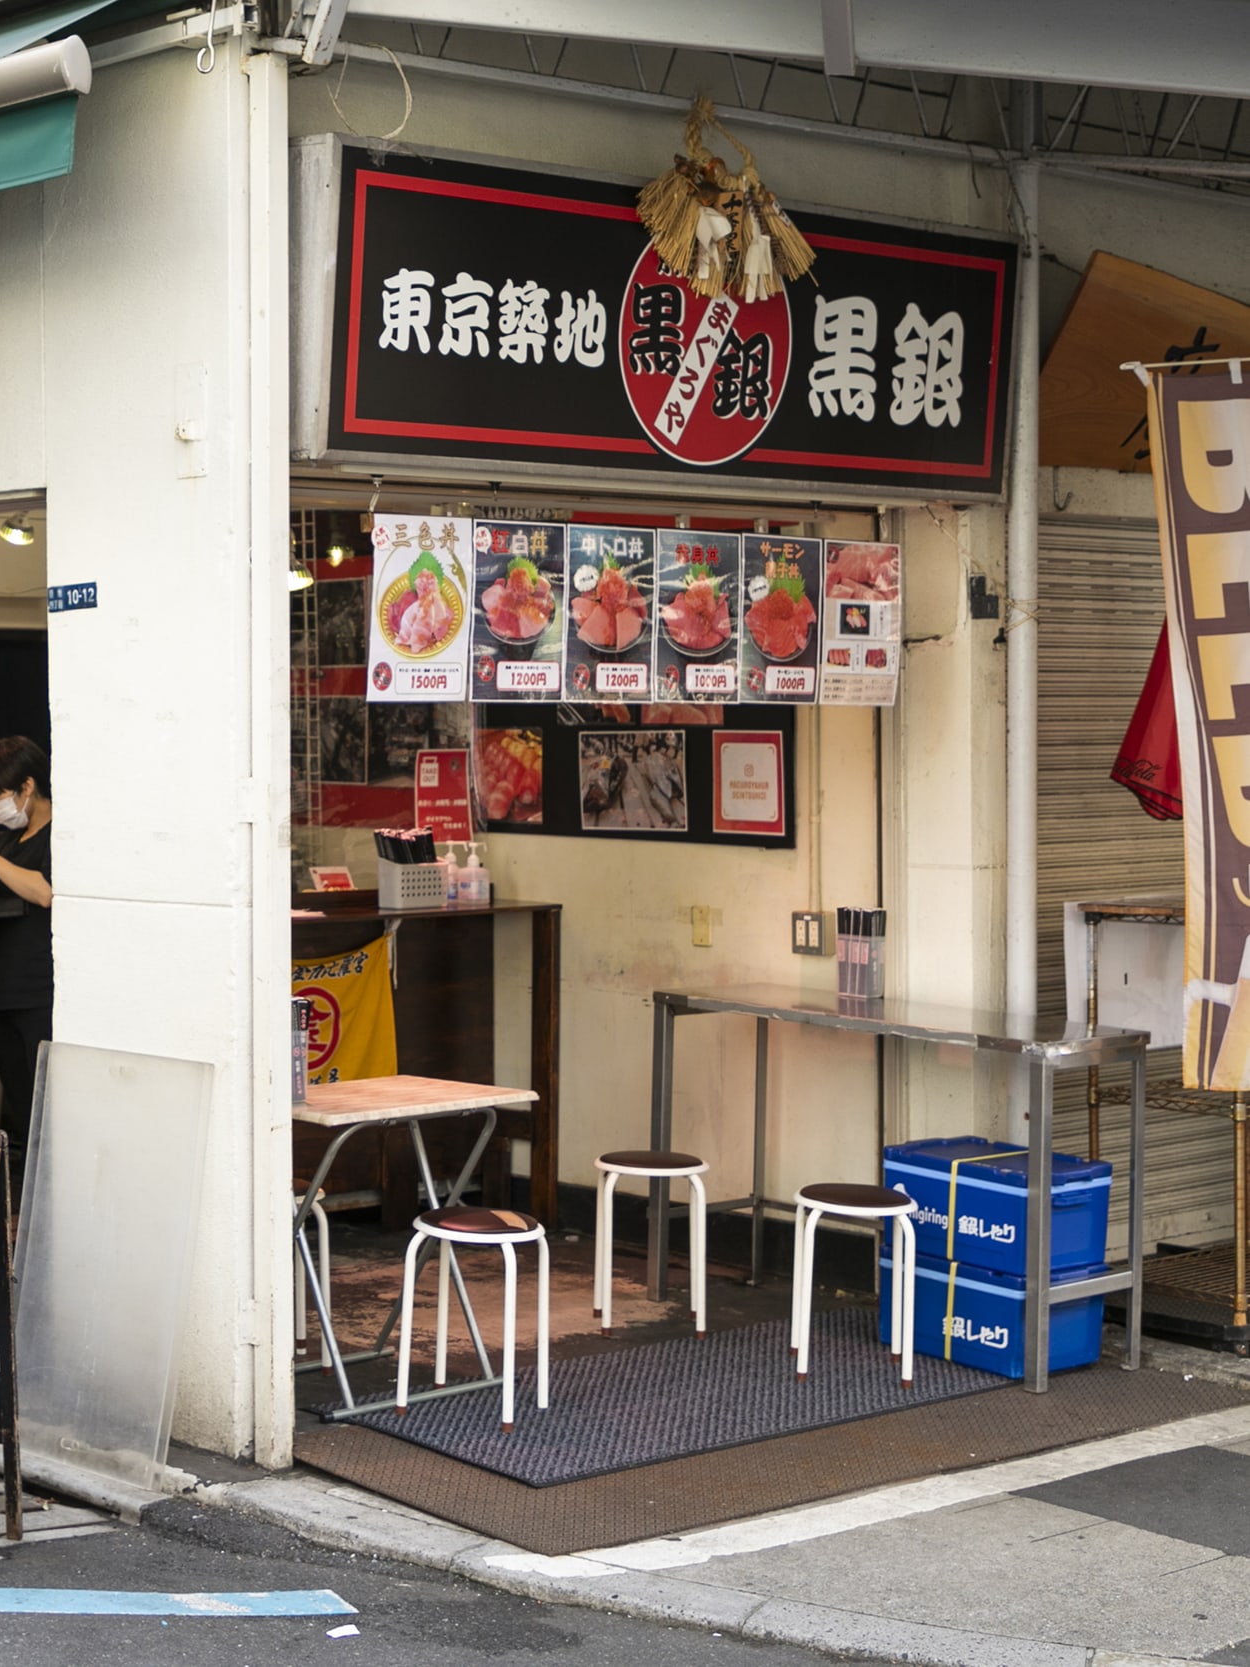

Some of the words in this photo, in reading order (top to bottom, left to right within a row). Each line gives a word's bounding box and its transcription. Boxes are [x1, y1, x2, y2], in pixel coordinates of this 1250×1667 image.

[379, 267, 607, 368] 東京築地
[808, 295, 966, 429] 黒銀
[629, 282, 685, 377] 黒
[712, 326, 773, 421] 銀
[662, 300, 733, 435] まぐろや
[392, 521, 460, 550] 三色丼
[491, 529, 548, 556] 紅白丼
[582, 534, 644, 559] 中トロ丼
[675, 543, 720, 566] 赤身丼
[760, 541, 806, 560] サーモン
[764, 561, 800, 580] 親子丼
[66, 587, 95, 606] 10-12
[410, 675, 447, 690] 1500円
[510, 672, 547, 686] 1200円
[605, 673, 639, 688] 1200円
[694, 674, 728, 688] 1000円
[776, 677, 806, 690] 1000円
[957, 1214, 1016, 1245] 銀しゃり
[941, 1316, 1010, 1350] 銀しゃり
